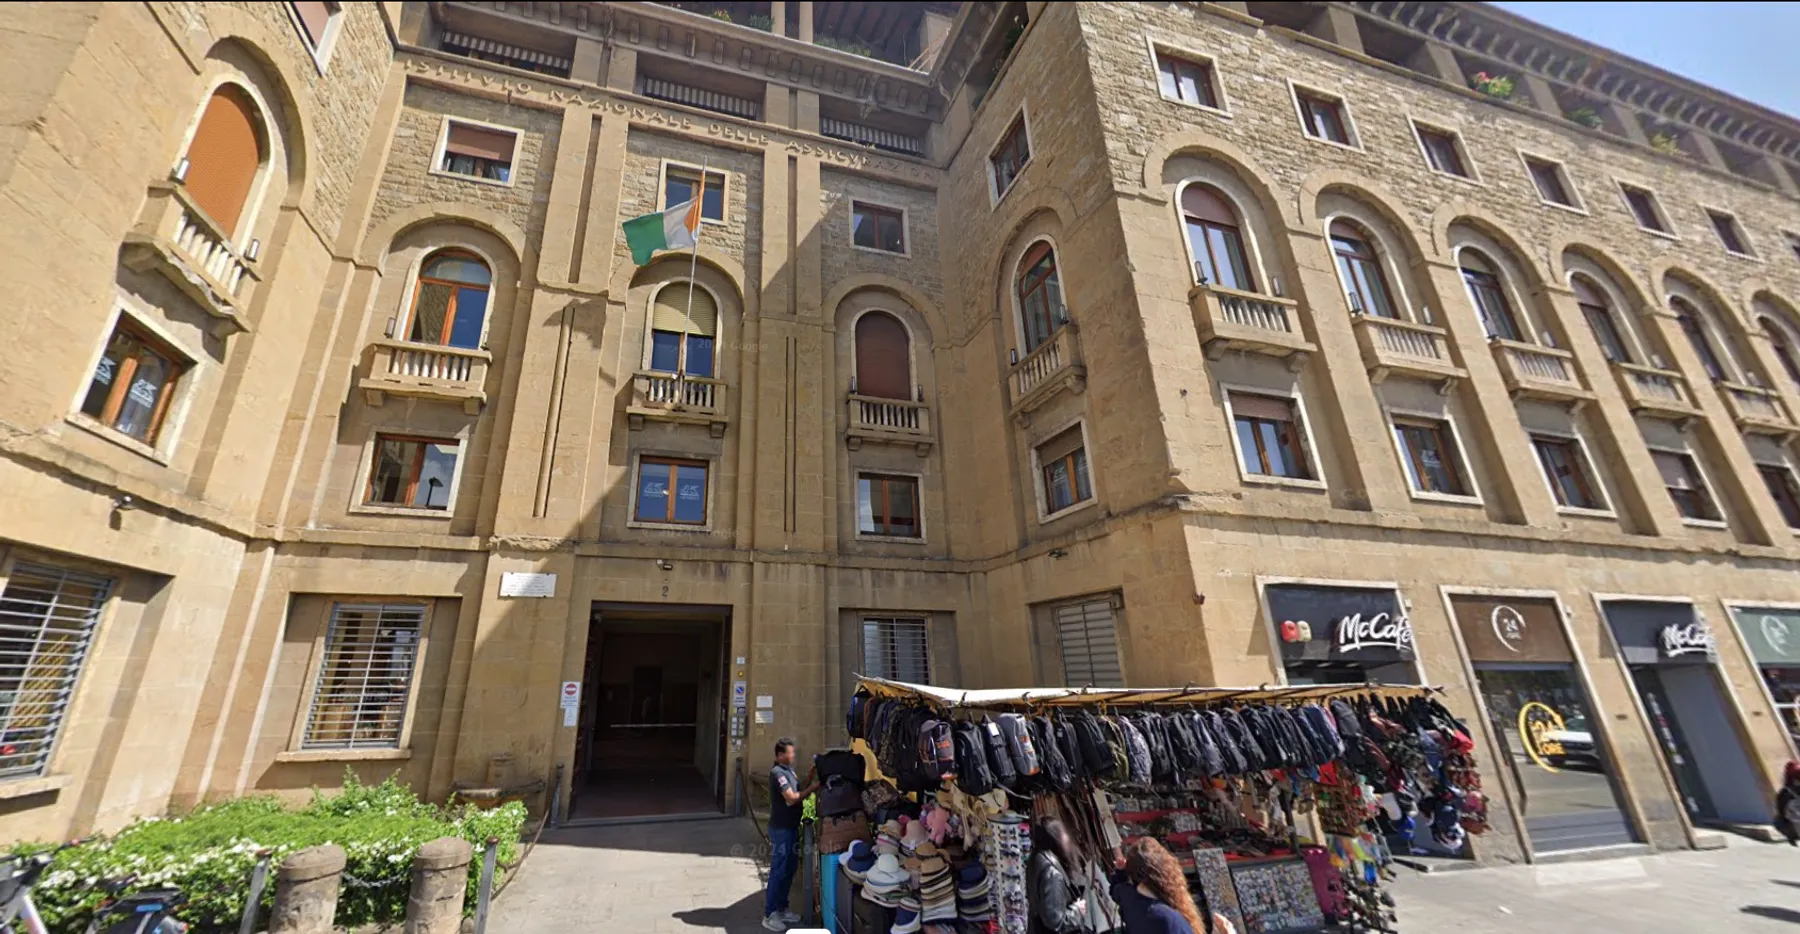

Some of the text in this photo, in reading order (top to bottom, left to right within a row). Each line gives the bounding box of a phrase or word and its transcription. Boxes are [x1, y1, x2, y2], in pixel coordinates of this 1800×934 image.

[548, 89, 692, 130] NAZIONALE
[708, 123, 770, 146] DELLE
[661, 585, 669, 597] 2
